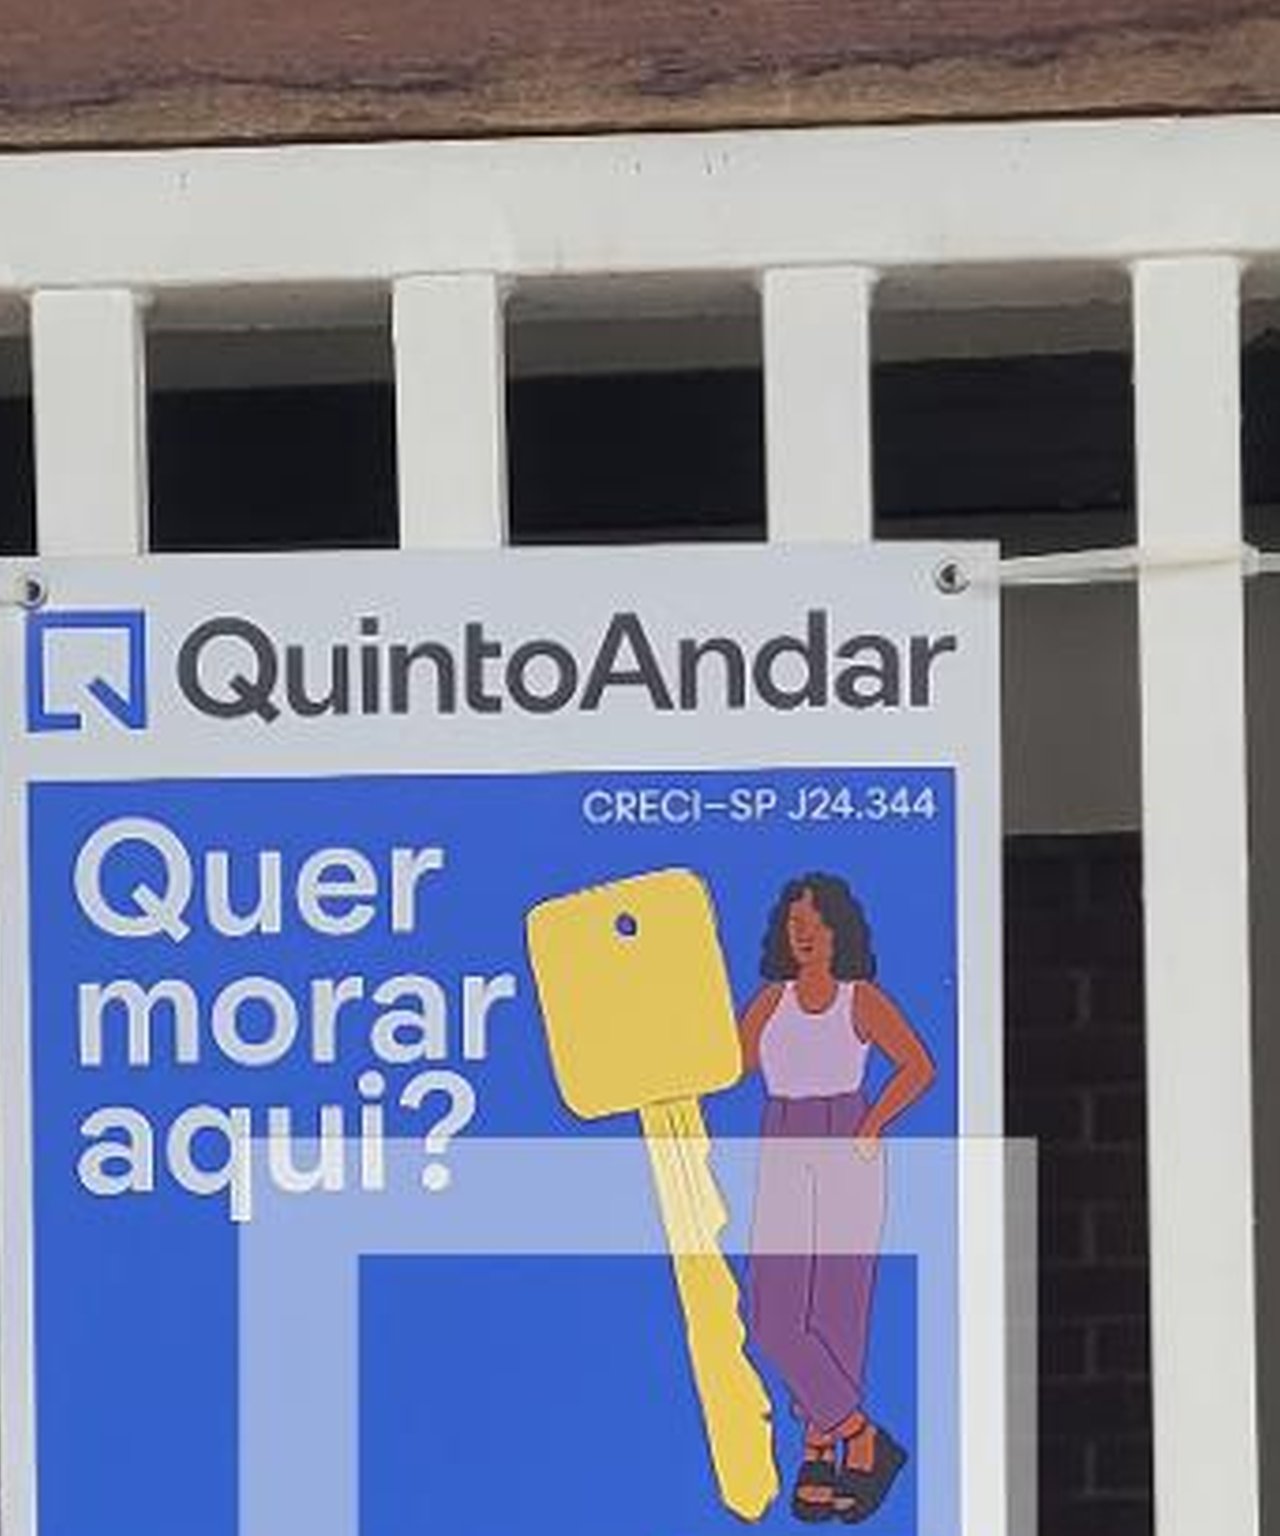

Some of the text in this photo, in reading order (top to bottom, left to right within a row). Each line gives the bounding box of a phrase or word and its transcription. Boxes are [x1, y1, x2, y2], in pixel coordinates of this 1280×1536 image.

[175, 610, 956, 724] QuintoAndar
[582, 786, 936, 825] CRECI-SP J24.344
[73, 815, 444, 943] Quer
[78, 971, 516, 1066] morar
[75, 1067, 476, 1222] aqui?
